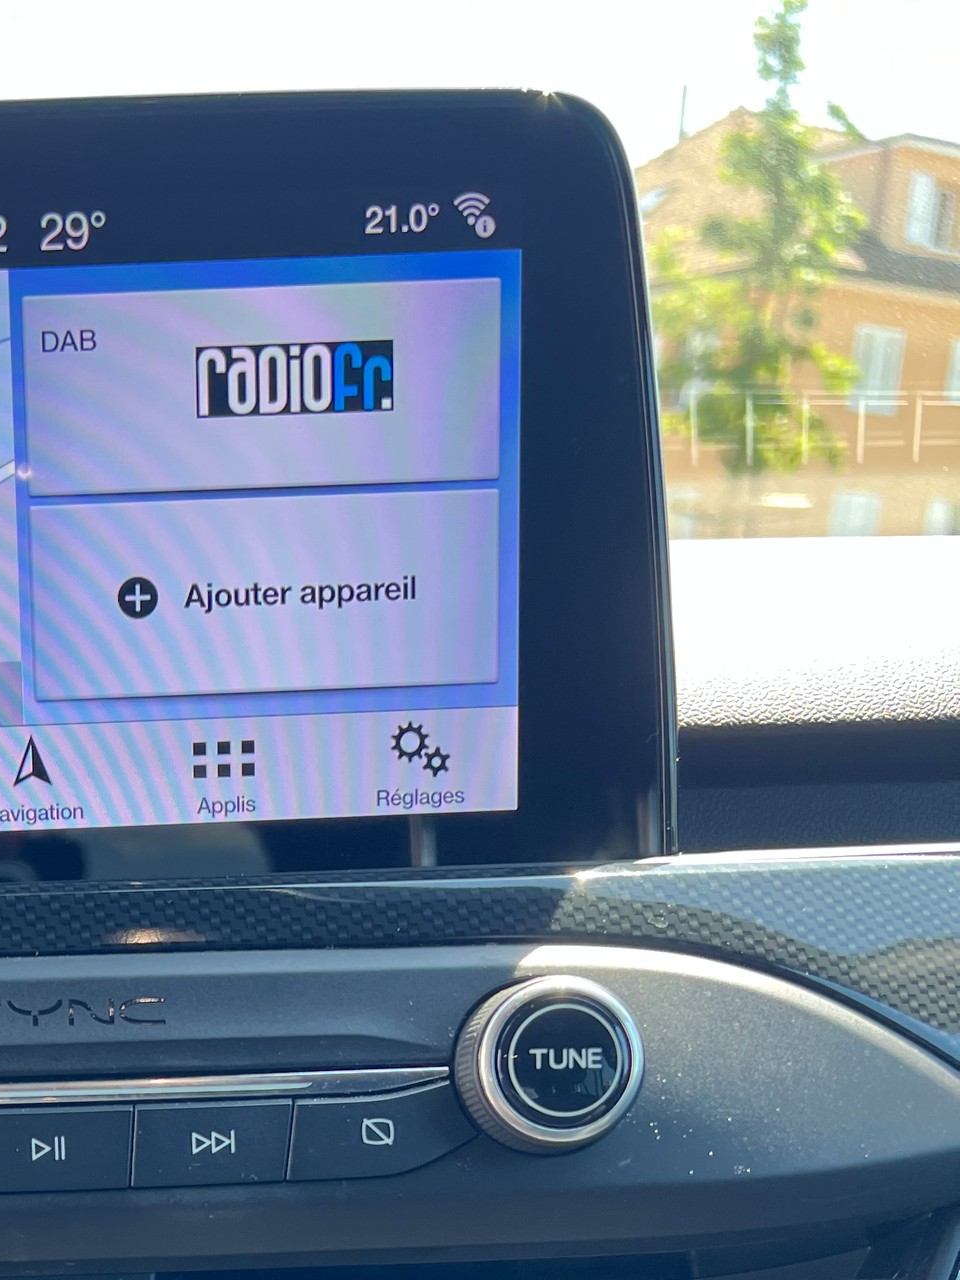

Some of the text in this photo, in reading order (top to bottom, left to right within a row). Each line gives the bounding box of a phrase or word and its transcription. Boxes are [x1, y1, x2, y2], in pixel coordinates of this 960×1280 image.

[40, 210, 107, 251] 29°
[365, 203, 440, 235] 21.0°
[41, 330, 97, 352] DAB
[184, 575, 417, 614] Ajouter appareil
[197, 796, 256, 817] Applis
[376, 786, 465, 809] Réglages
[528, 1046, 603, 1071] TUNE
